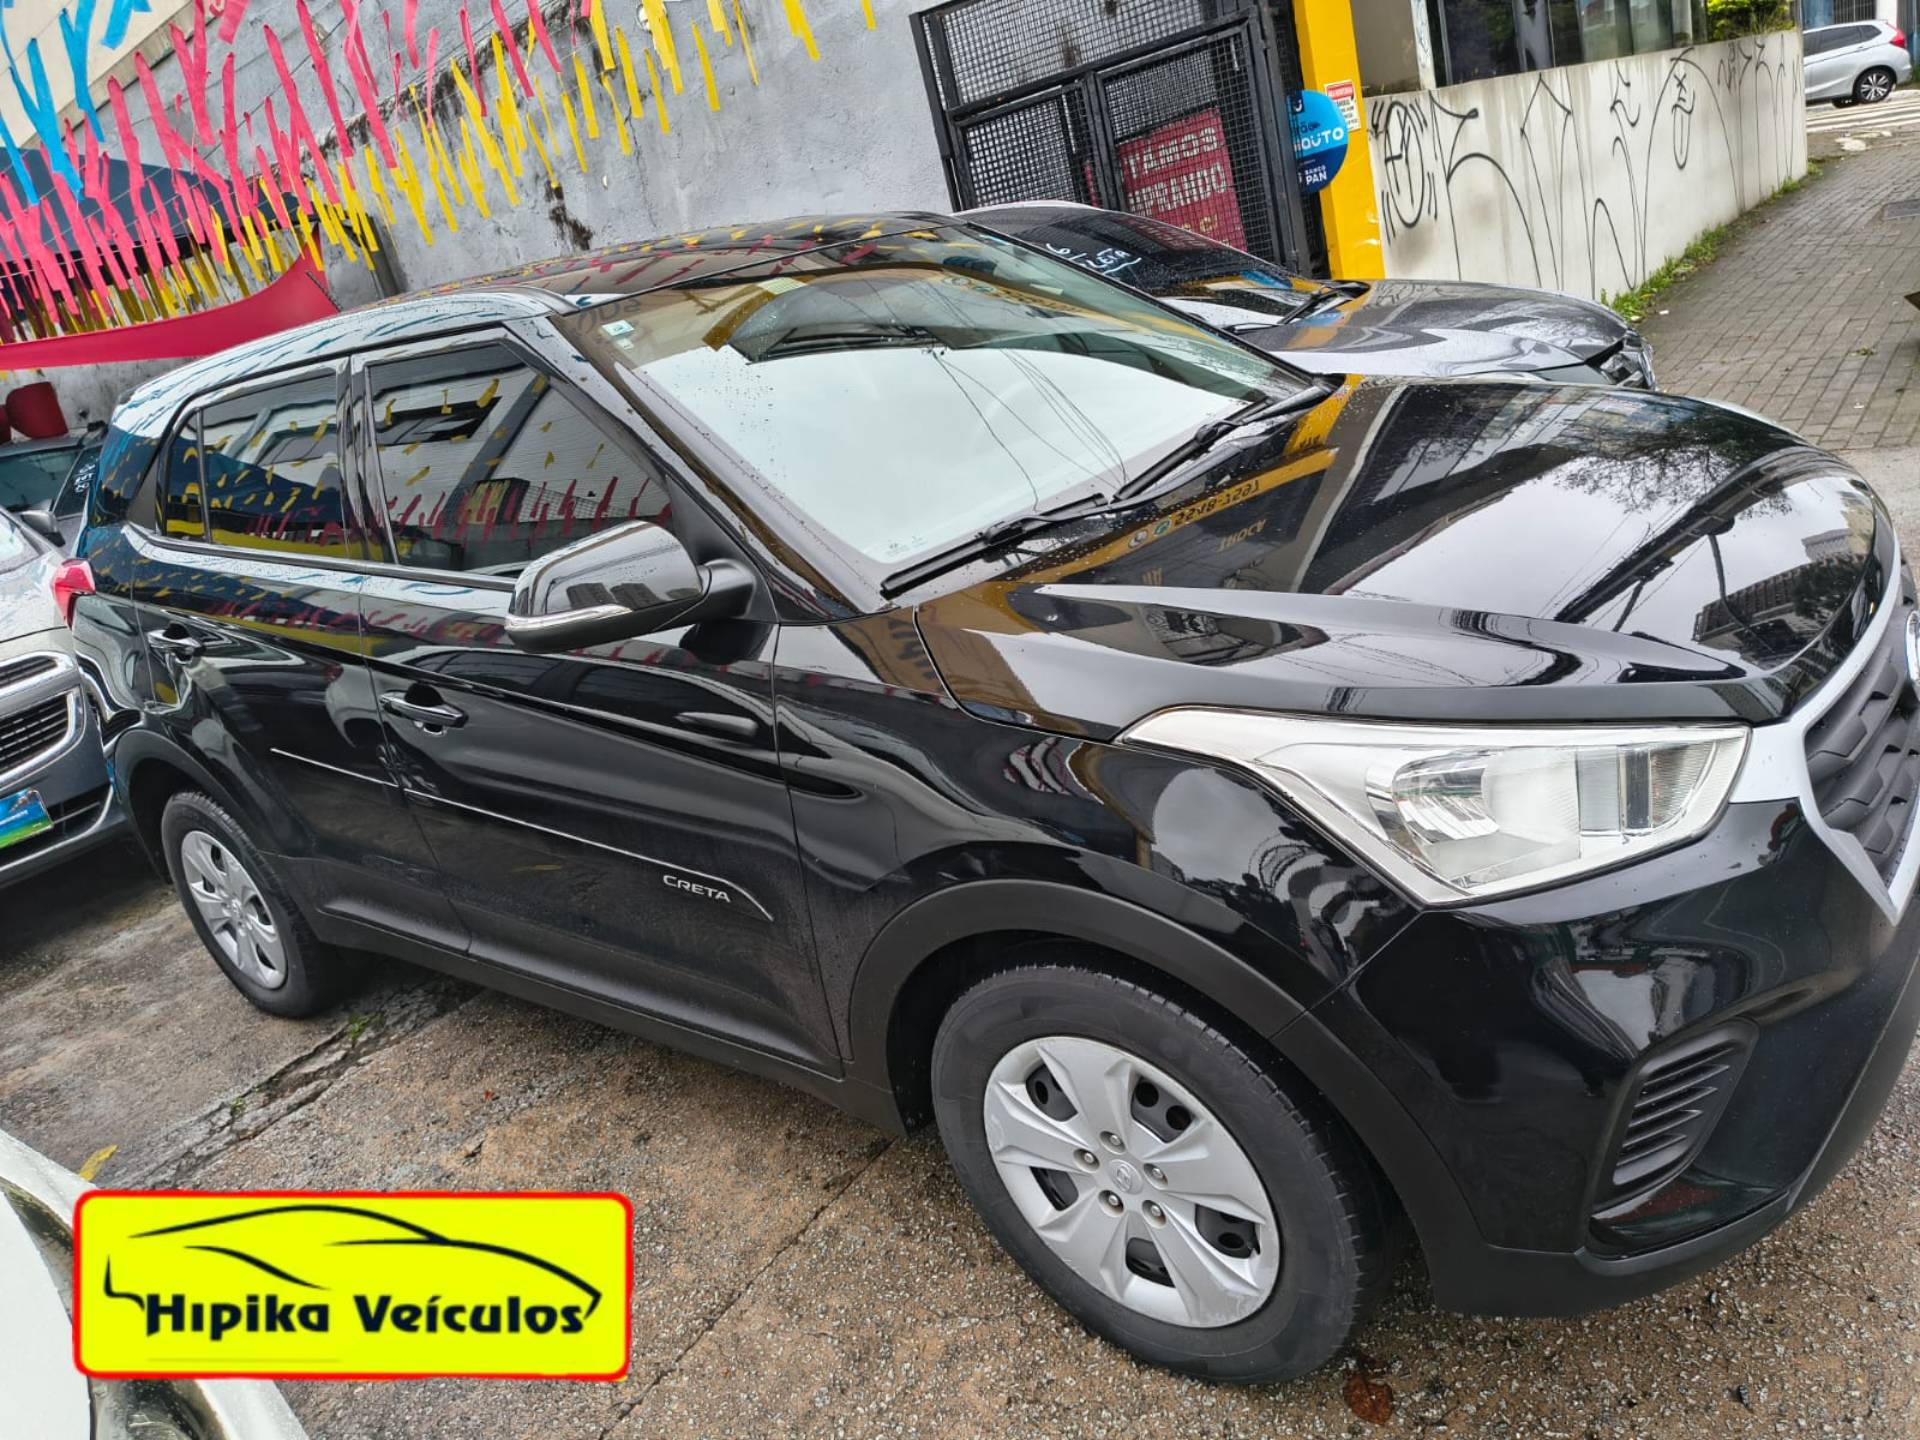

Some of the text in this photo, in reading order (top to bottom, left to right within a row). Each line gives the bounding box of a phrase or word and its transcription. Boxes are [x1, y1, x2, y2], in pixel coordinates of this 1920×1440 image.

[1125, 128, 1217, 178] TAMOS
[1128, 162, 1226, 217] MPRANDO
[1306, 171, 1328, 184] PAN
[663, 875, 731, 902] CRETA
